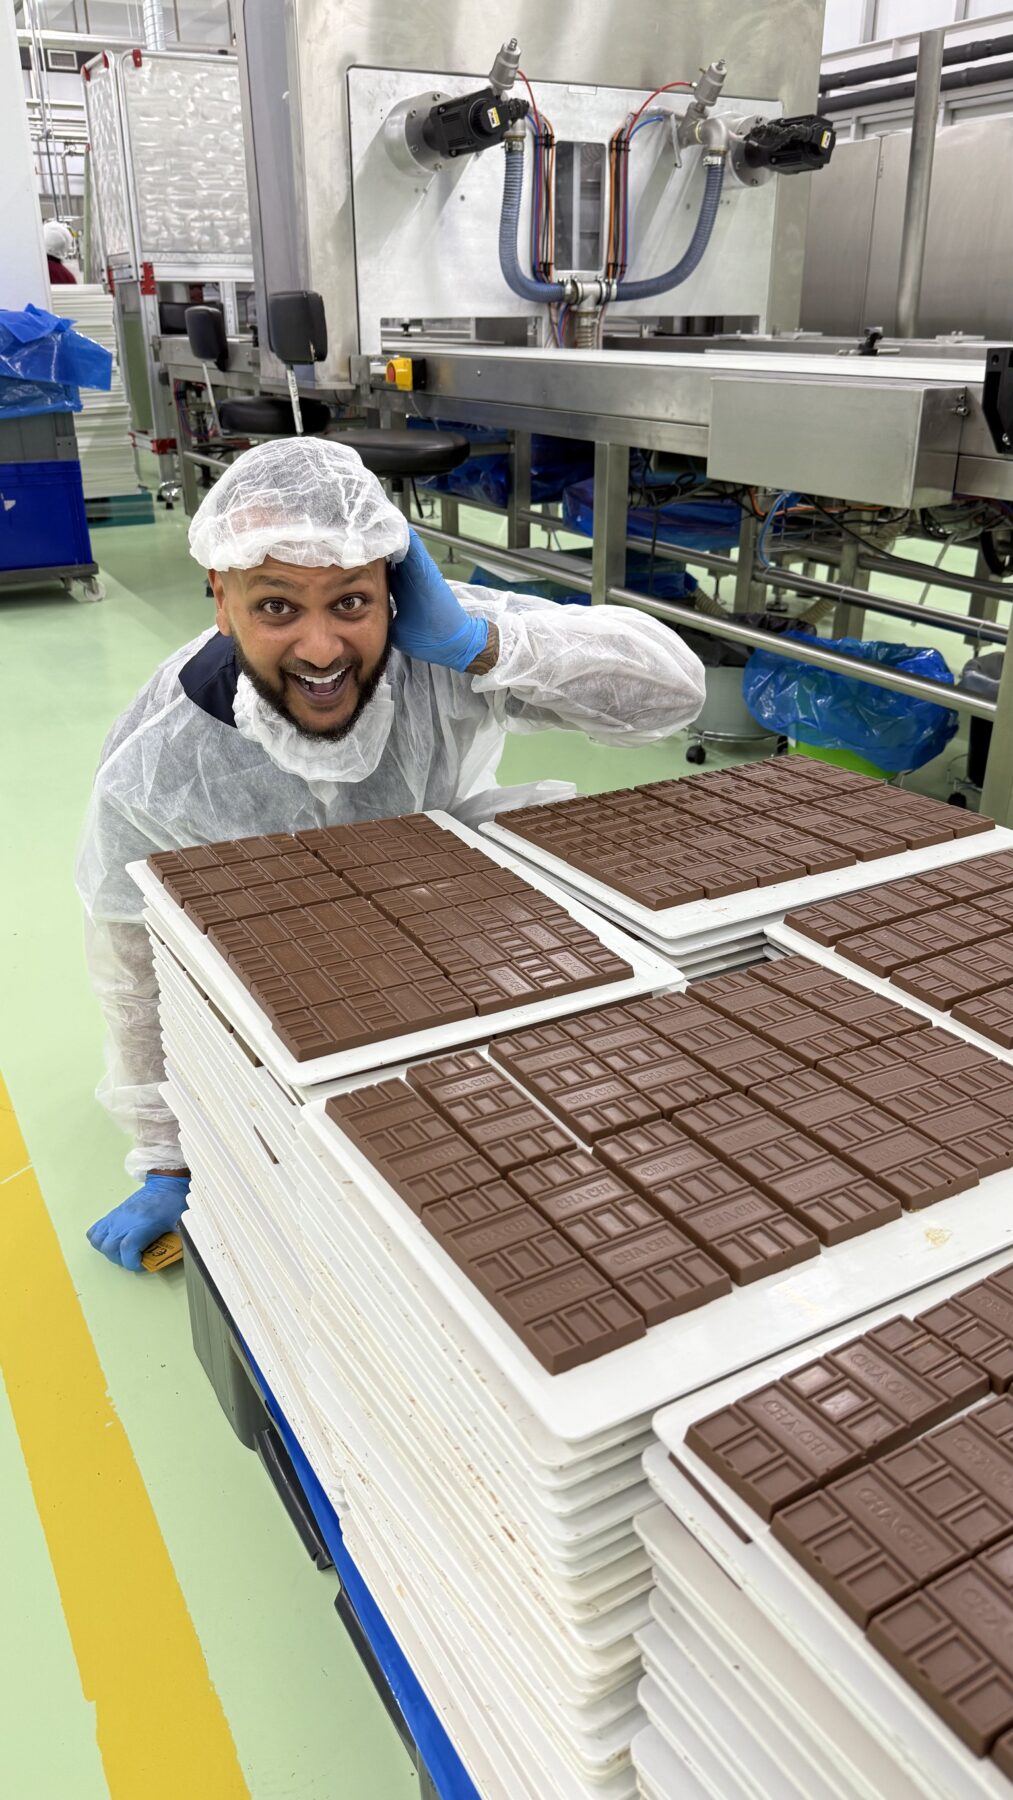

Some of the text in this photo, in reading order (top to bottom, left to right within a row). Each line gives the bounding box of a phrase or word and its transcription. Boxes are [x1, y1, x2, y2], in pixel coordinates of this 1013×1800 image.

[442, 1074, 496, 1096] CHACHI
[637, 1062, 689, 1084] CHACHI
[566, 1083, 620, 1106] CHACHI
[481, 1112, 538, 1137] CHACHI
[640, 1150, 699, 1177] CHACHI
[555, 1181, 617, 1210] CHACHI
[702, 1199, 764, 1230] CHACHI
[609, 1233, 677, 1266] CHACHI
[850, 1352, 923, 1406] CHACHI
[763, 1399, 836, 1457] CHACHI
[856, 1487, 930, 1553] CHACHI
